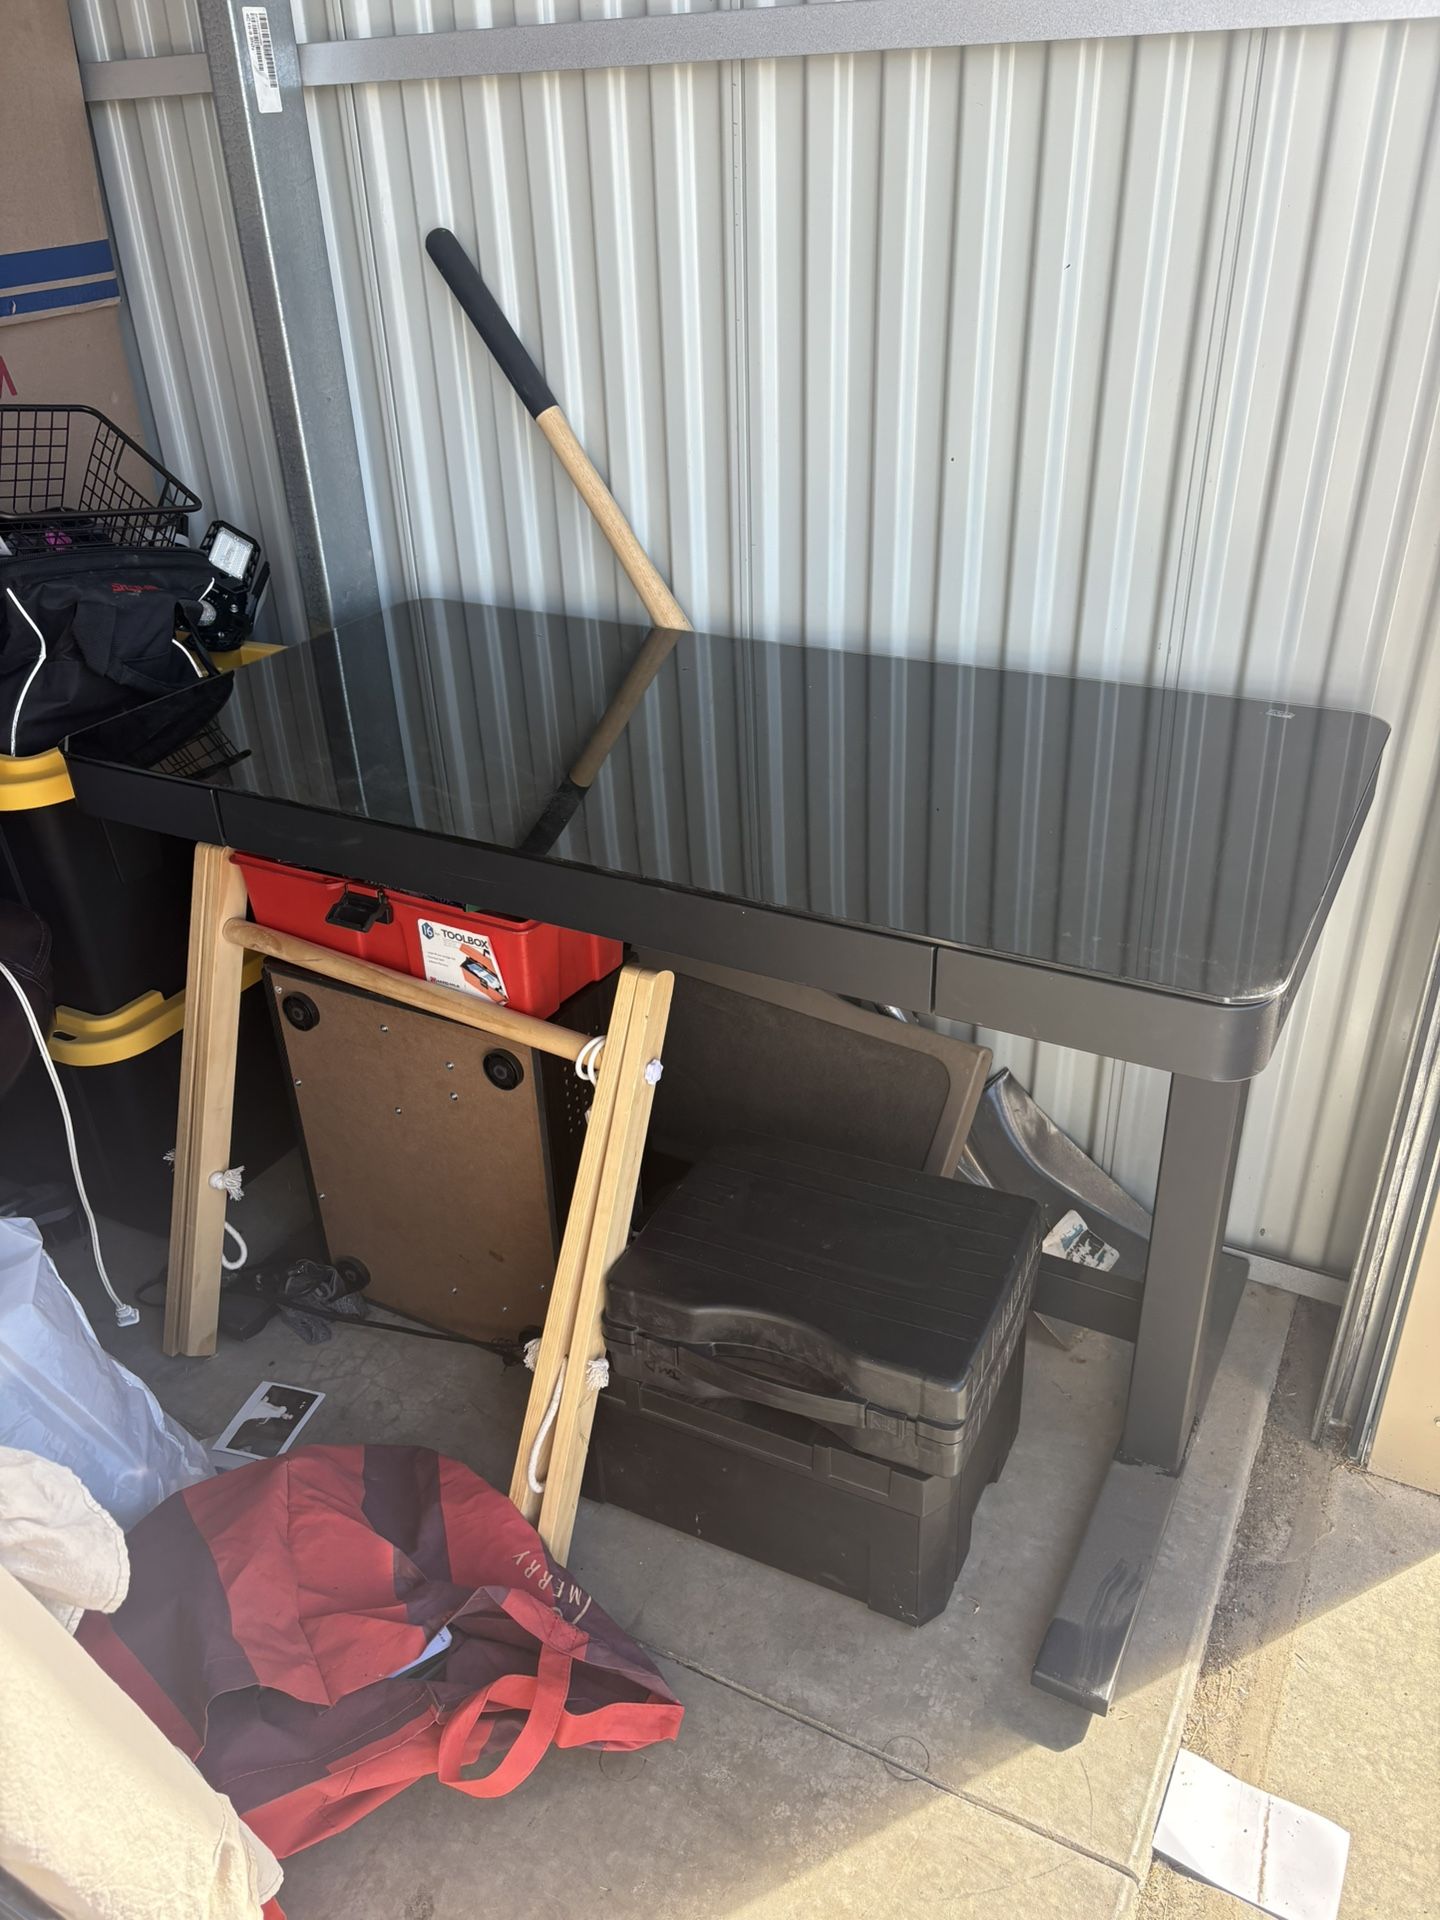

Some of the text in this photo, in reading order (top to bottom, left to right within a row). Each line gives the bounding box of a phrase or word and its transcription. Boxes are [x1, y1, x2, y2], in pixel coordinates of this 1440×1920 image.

[422, 925, 433, 937] 16
[440, 928, 489, 949] TOOLBOX
[512, 1550, 582, 1606] MERRY
